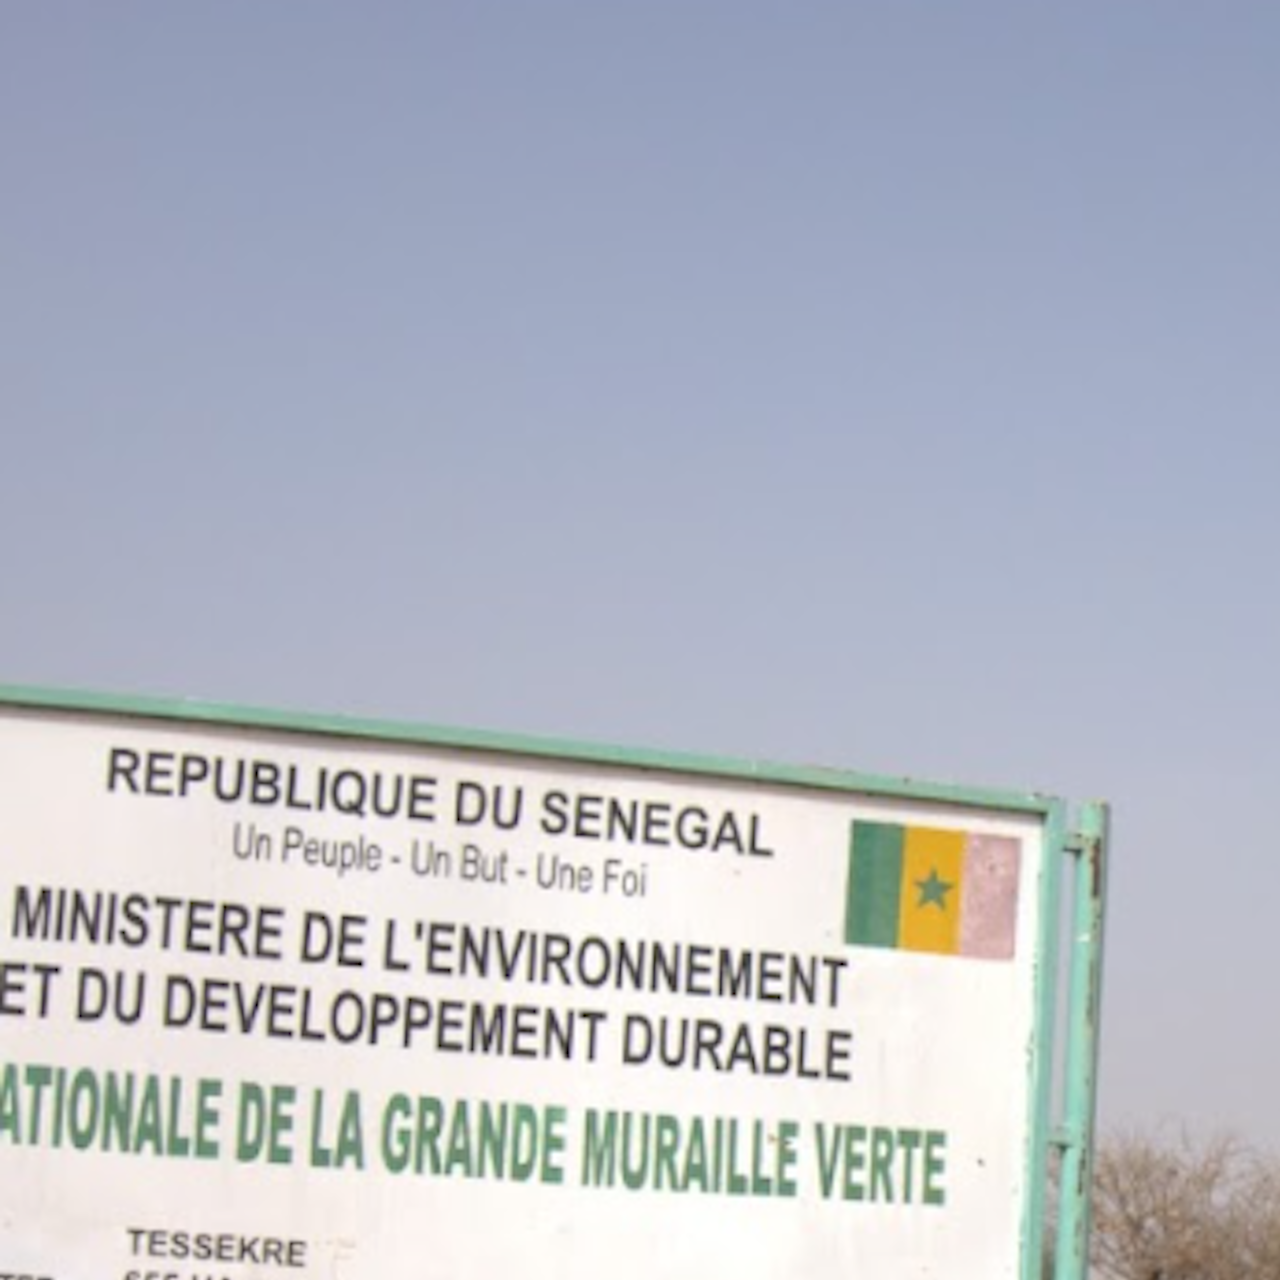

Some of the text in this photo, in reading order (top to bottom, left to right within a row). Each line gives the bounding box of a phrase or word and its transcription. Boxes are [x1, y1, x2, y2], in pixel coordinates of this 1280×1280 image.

[106, 747, 774, 858] REPUBLIQUE DU SENEGAL
[234, 823, 271, 860] Un
[281, 826, 381, 879] Peuple
[412, 841, 450, 876] Un
[460, 844, 508, 884] But
[536, 854, 593, 893] Une
[603, 859, 645, 897] Foi
[11, 885, 849, 1008] MINISTERE DE L'ENVIRONNEMENT
[0, 961, 853, 1082] ET DU DEVELOPPEMENT DURABLE
[235, 1081, 296, 1164] DE
[309, 1088, 364, 1170] LA
[380, 1093, 566, 1185] GRANDE
[581, 1108, 799, 1197] MURAILLE
[814, 1122, 946, 1206] VERTE
[127, 1228, 306, 1267] TESSEKRE
